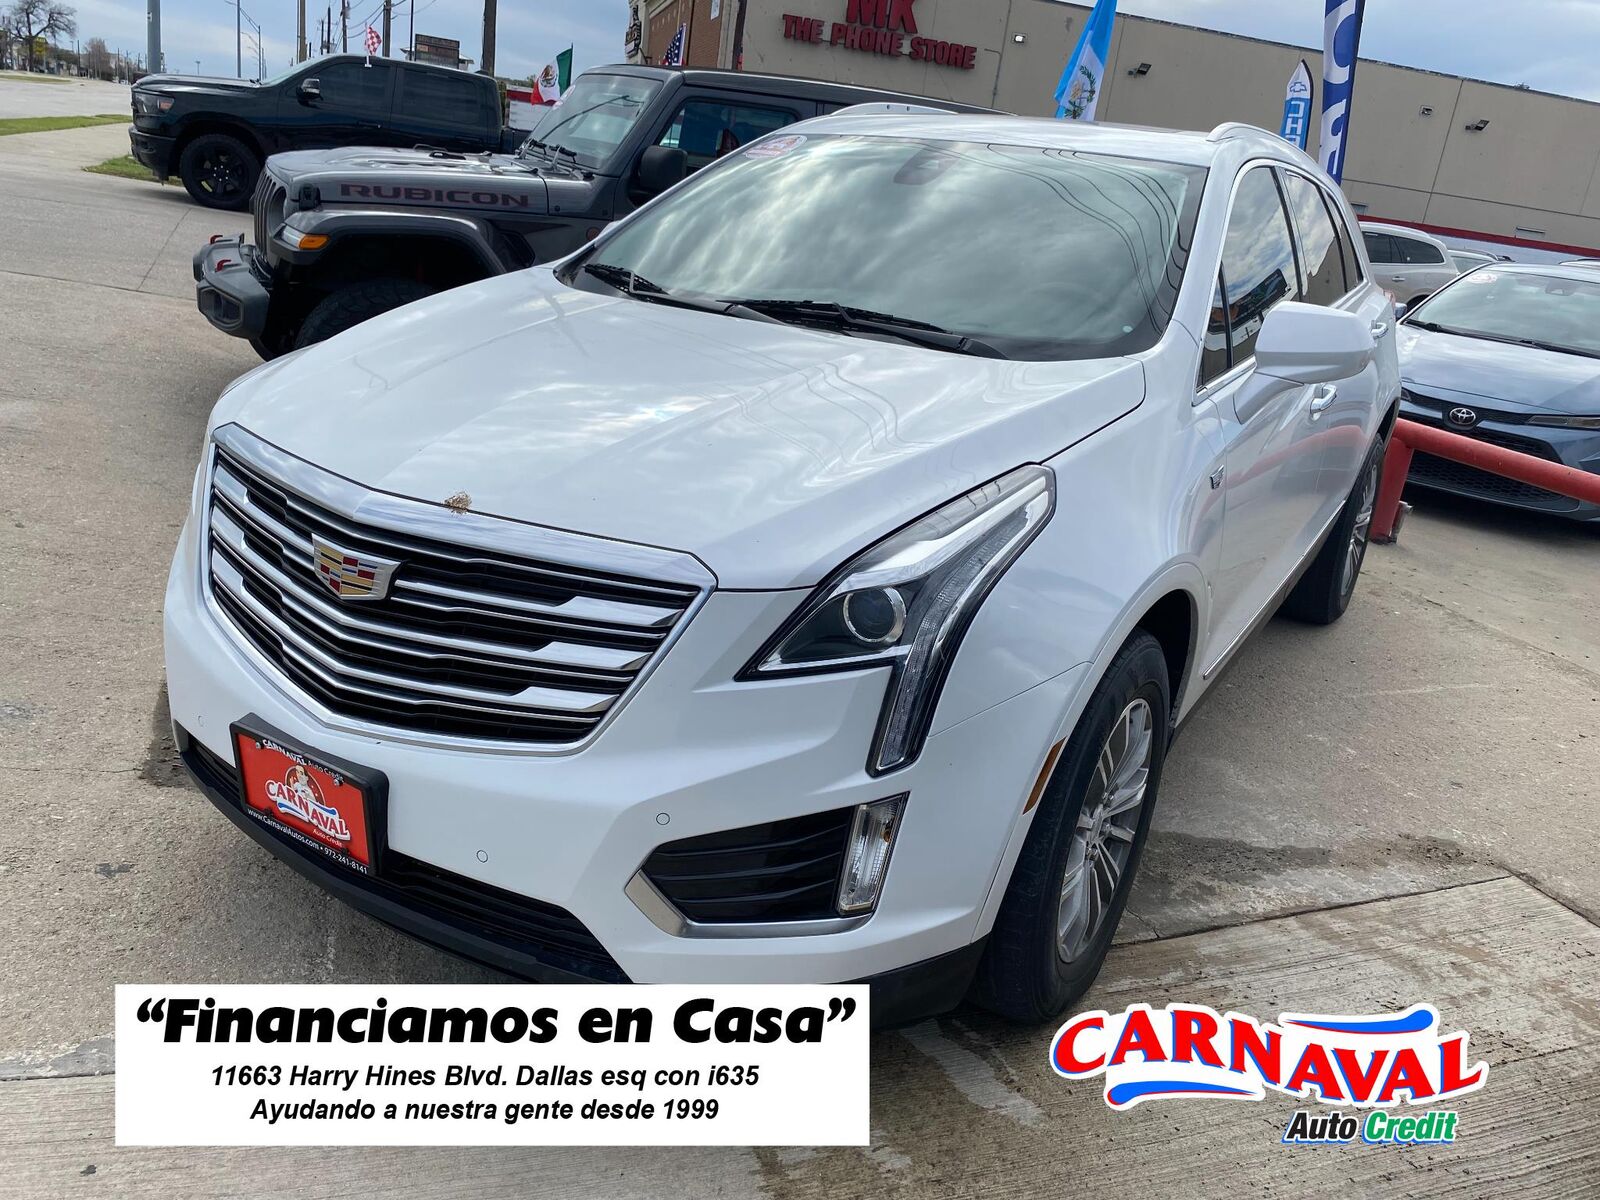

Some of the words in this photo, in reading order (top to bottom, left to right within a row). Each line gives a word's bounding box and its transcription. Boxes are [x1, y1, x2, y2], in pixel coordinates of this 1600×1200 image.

[846, 0, 918, 34] MK
[783, 14, 825, 43] THE
[830, 22, 905, 57] PHONE
[909, 36, 977, 70] STORE
[340, 183, 529, 207] RUBICON
[262, 739, 307, 766] CARNAVAL
[265, 780, 350, 838] CARNAVAL
[247, 808, 320, 850] www.CarnavalAutos.com
[324, 848, 368, 874] 972-241-8141
[312, 828, 327, 839] Auto
[327, 834, 343, 847] Credit
